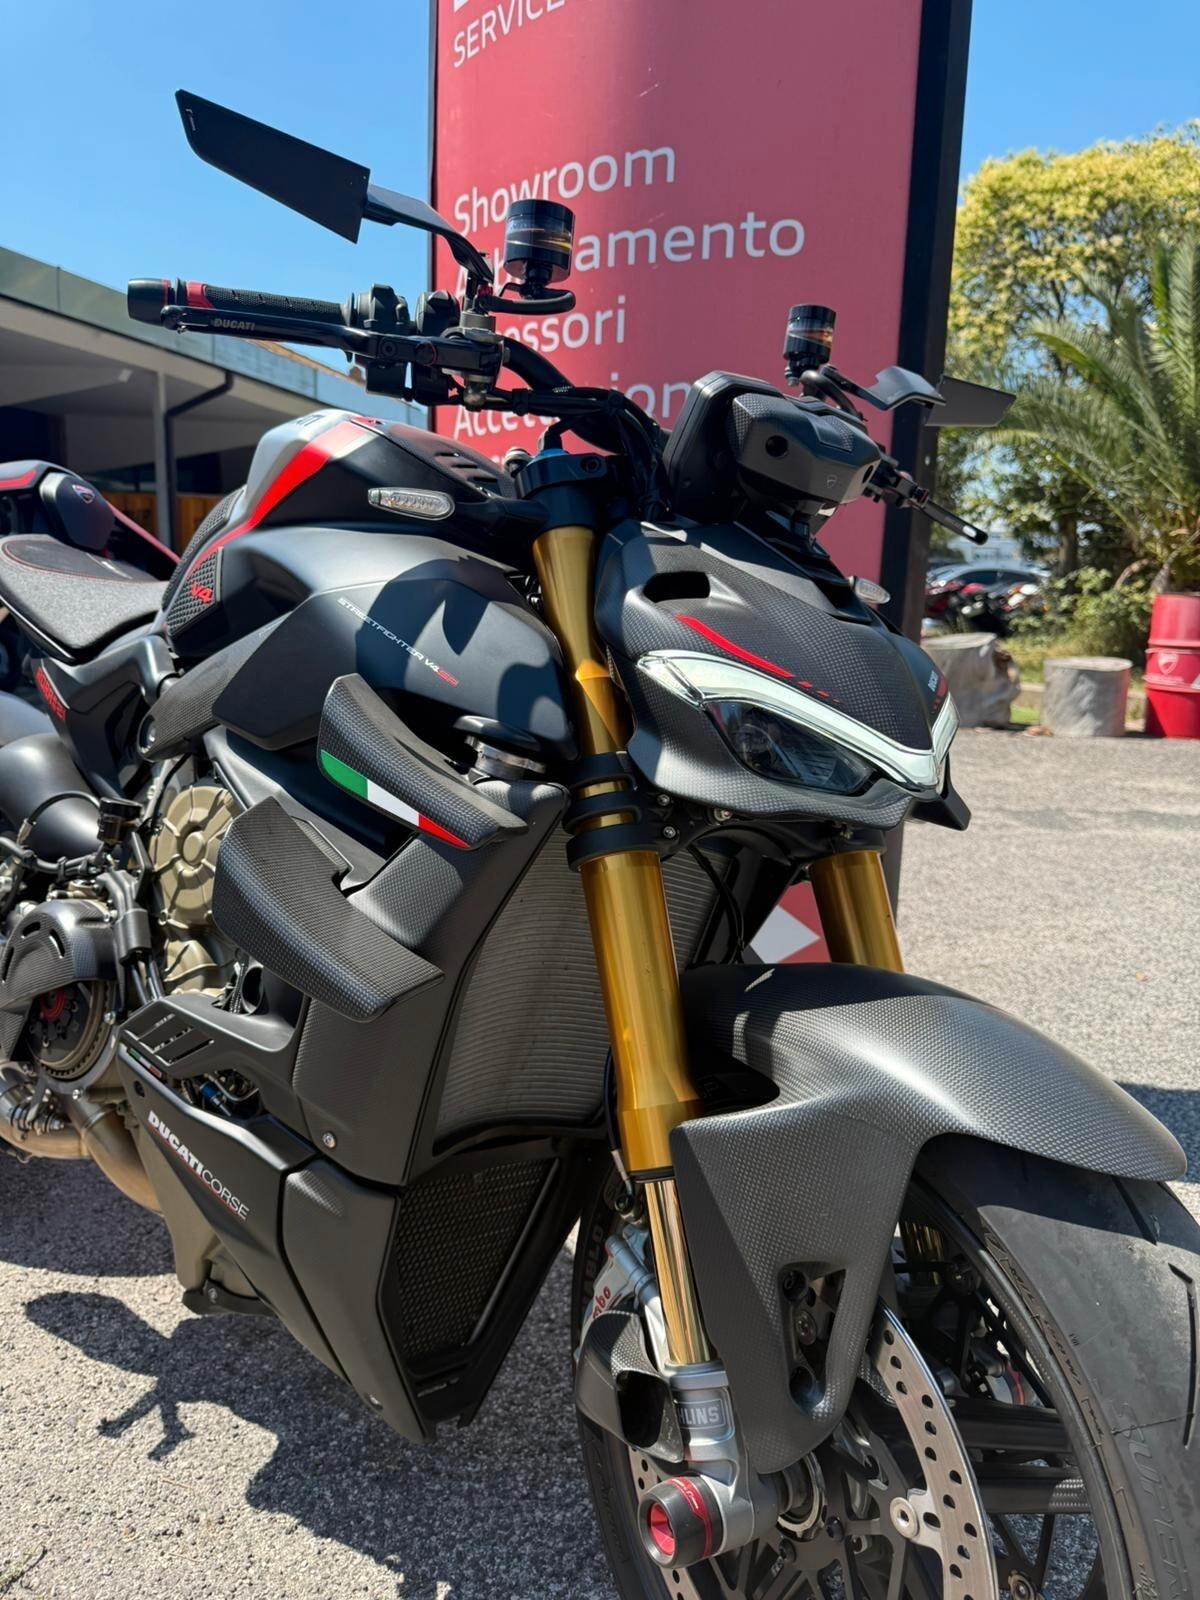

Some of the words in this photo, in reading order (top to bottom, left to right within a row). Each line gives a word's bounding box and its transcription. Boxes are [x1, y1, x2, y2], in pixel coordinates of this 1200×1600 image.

[454, 146, 676, 235] Showroom
[213, 317, 256, 332] DUCATI
[191, 581, 213, 604] V4
[337, 597, 425, 661] STREETFIGHTER
[678, 1406, 720, 1425] HLINS
